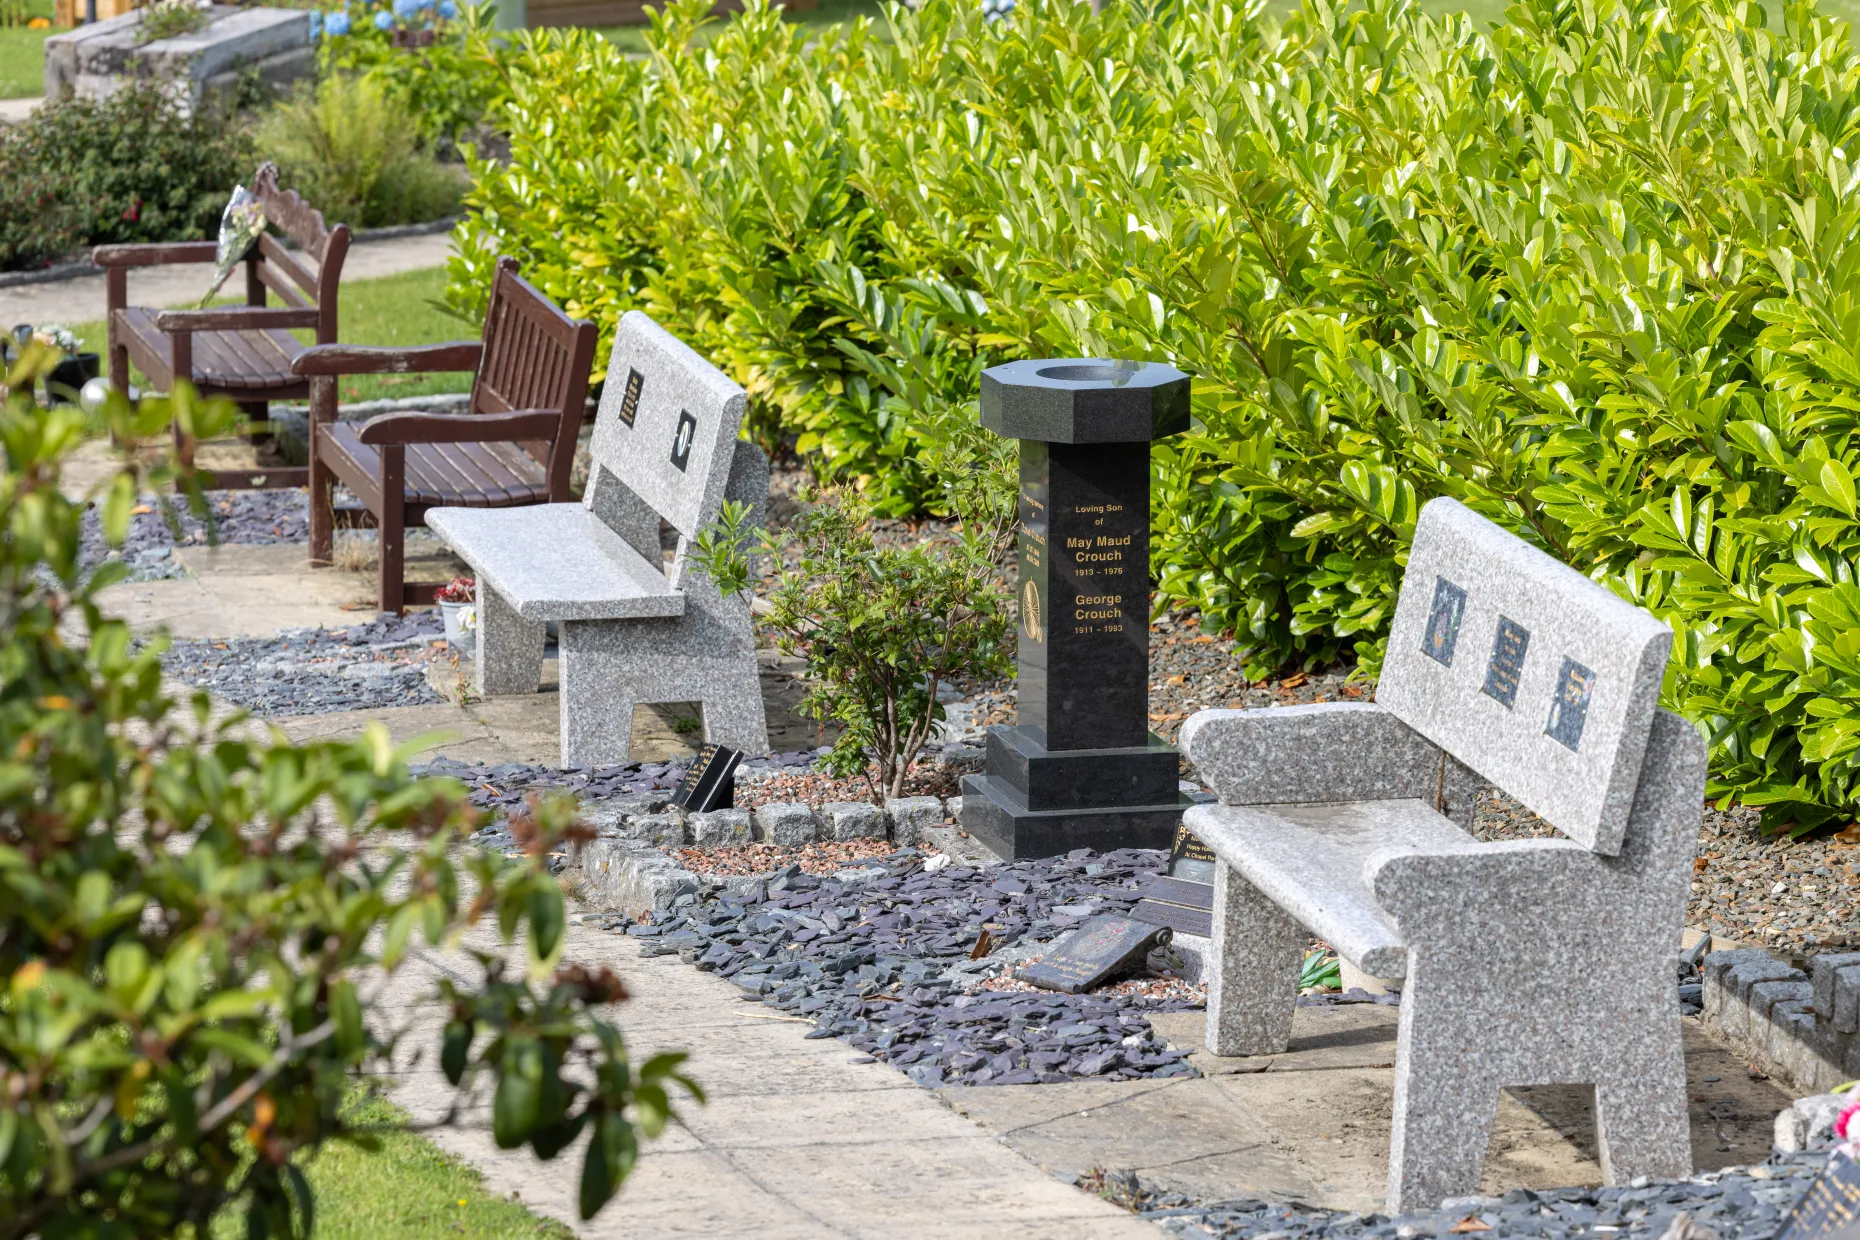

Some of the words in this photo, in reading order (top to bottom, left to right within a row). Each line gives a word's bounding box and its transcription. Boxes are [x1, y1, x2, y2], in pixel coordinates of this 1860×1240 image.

[1075, 505, 1104, 514] Loving
[1106, 504, 1123, 512] Son
[1095, 518, 1104, 526] of
[1067, 537, 1093, 550] May
[1096, 534, 1131, 547] Maud
[1075, 550, 1122, 562] Crouch
[1074, 568, 1094, 576] 1913
[1103, 567, 1123, 575] 1976
[1075, 594, 1122, 606] George
[1075, 607, 1122, 620] Crouch
[1074, 626, 1093, 634] 1911
[1103, 624, 1123, 632] 1993
